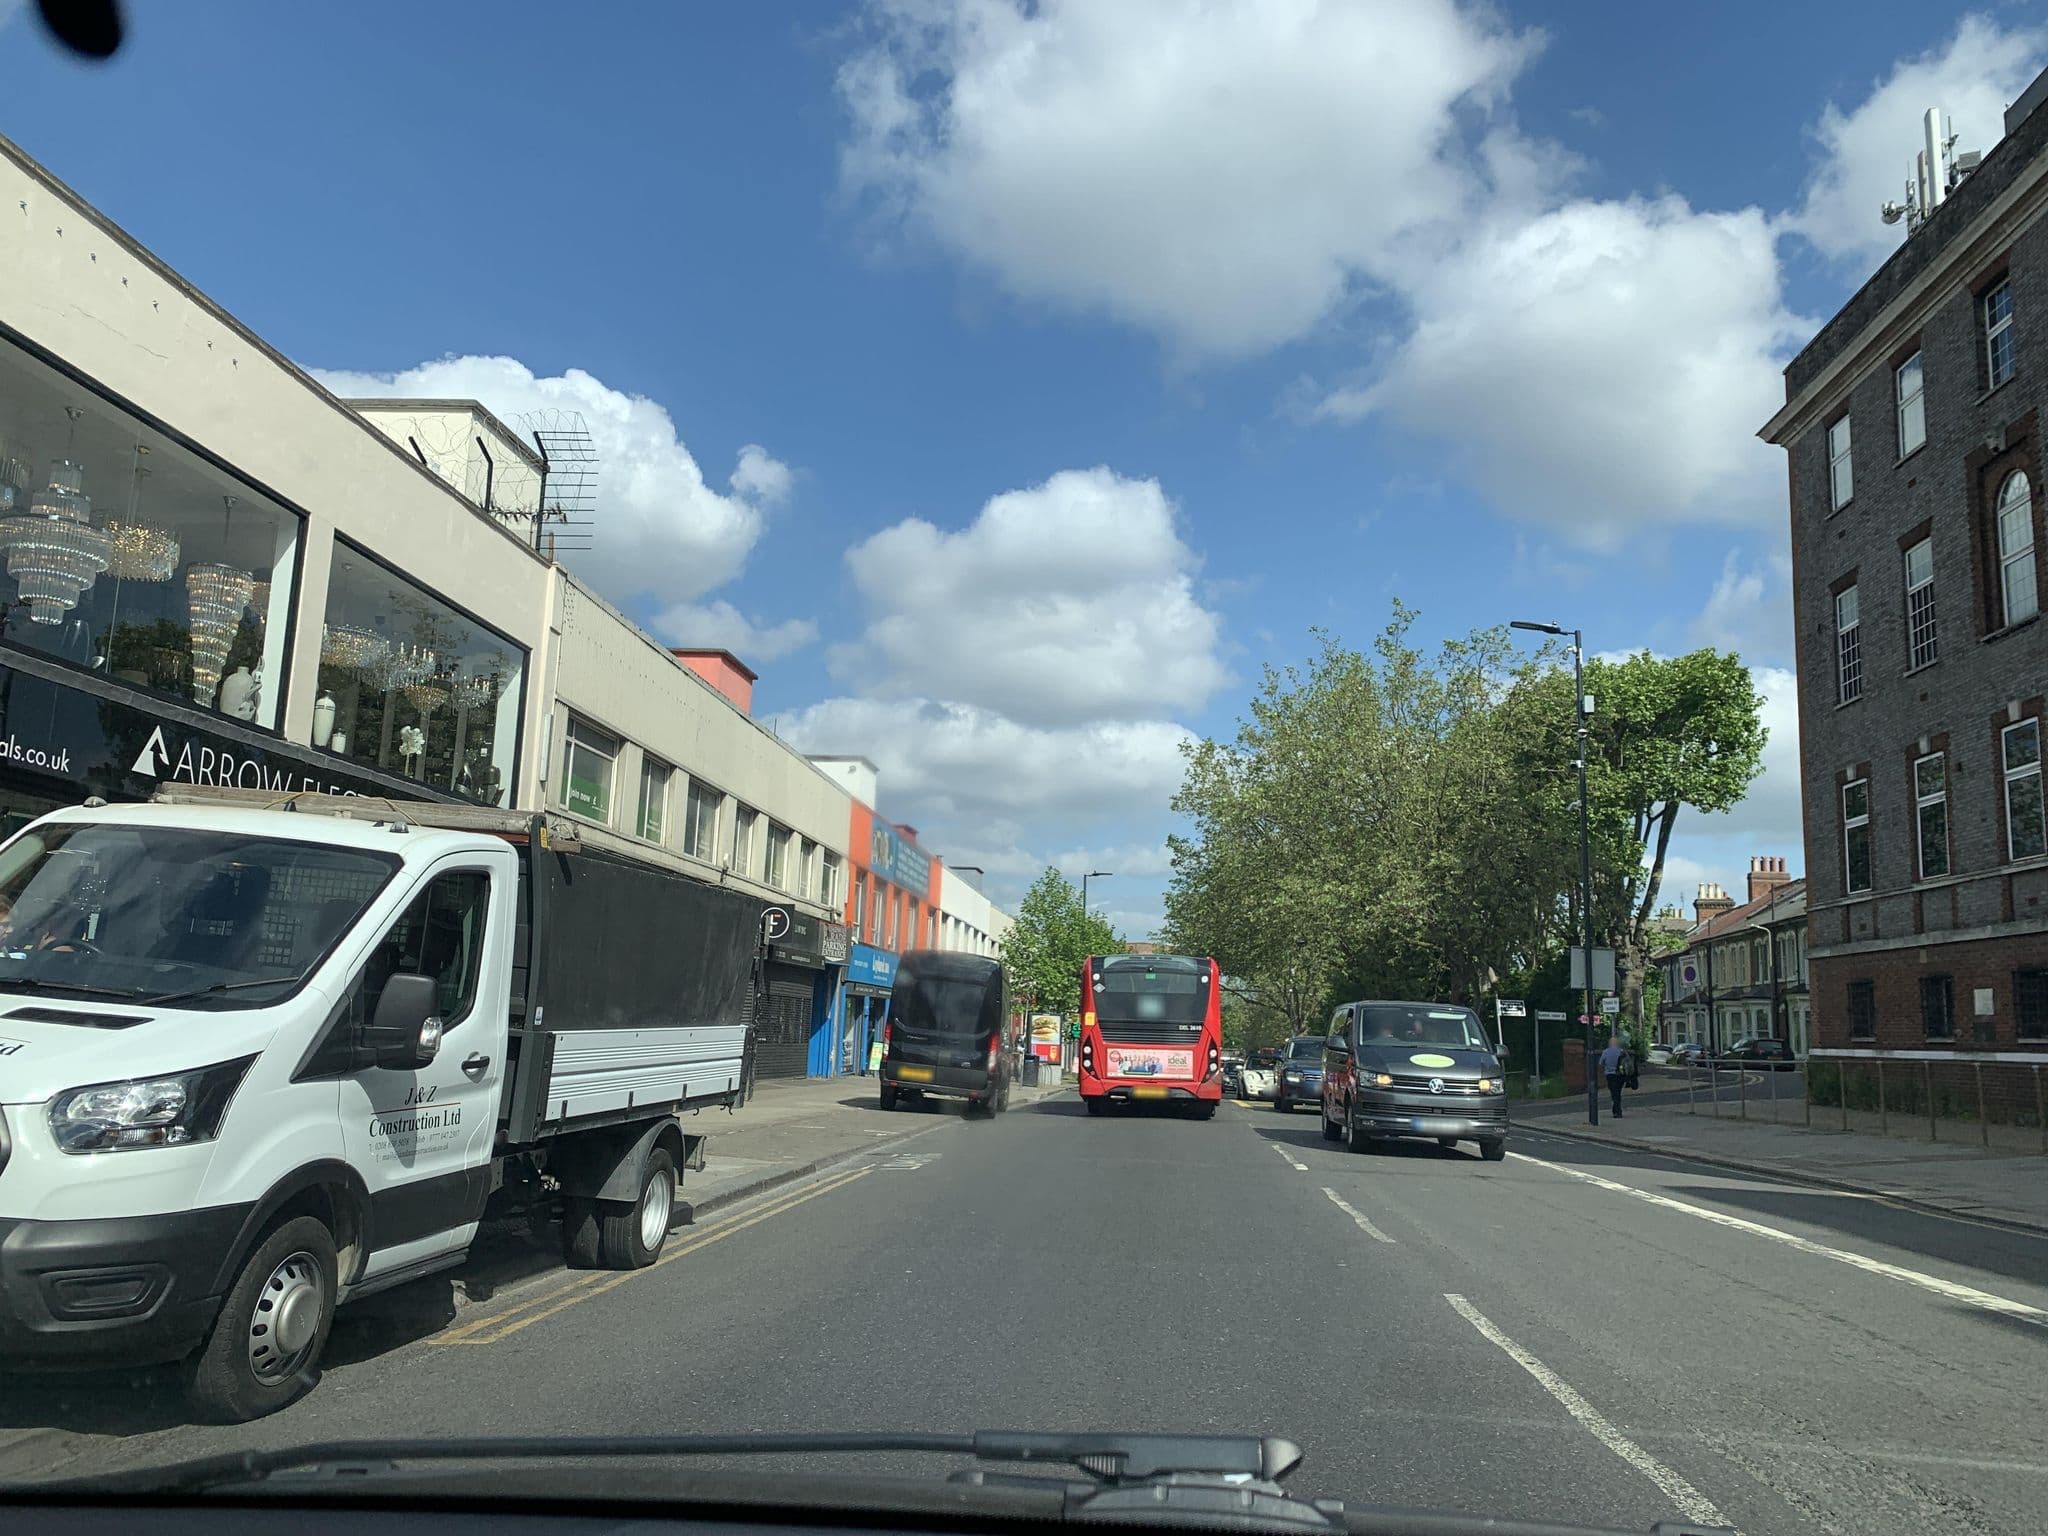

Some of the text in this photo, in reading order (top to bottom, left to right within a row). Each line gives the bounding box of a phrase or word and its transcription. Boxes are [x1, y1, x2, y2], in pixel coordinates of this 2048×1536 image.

[0, 734, 70, 773] als.co.uk
[173, 741, 293, 792] ARROW
[823, 940, 847, 951] PARKING
[404, 1085, 438, 1106] J & Z
[369, 1108, 461, 1138] Construction Ltd
